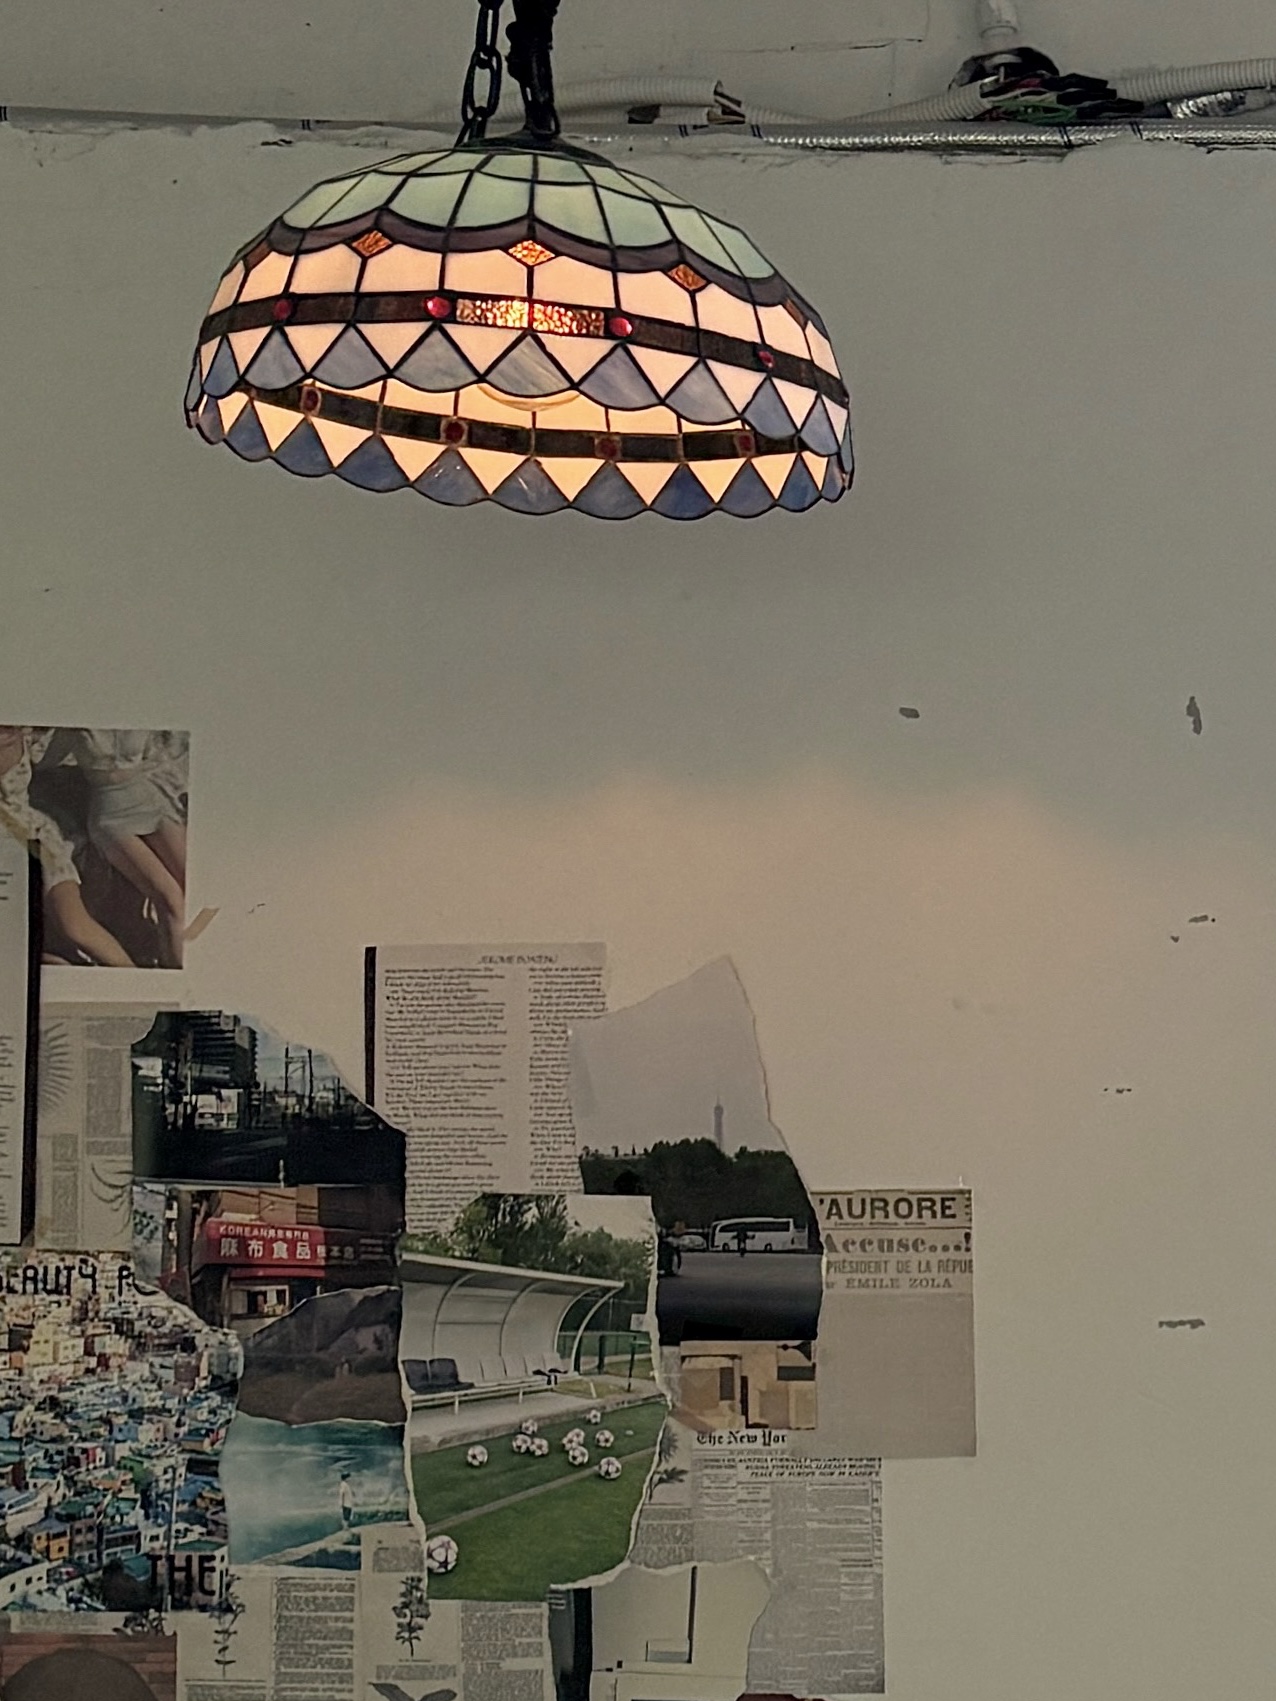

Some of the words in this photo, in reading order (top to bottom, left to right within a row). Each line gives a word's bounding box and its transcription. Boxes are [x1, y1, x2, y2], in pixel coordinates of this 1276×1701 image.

[896, 1259, 913, 1274] DE
[918, 1259, 932, 1274] LA
[0, 1257, 97, 1296] EAUTY
[908, 1278, 952, 1289] ZOLA
[697, 1431, 724, 1446] The
[727, 1430, 758, 1444] New
[147, 1554, 216, 1596] THE
